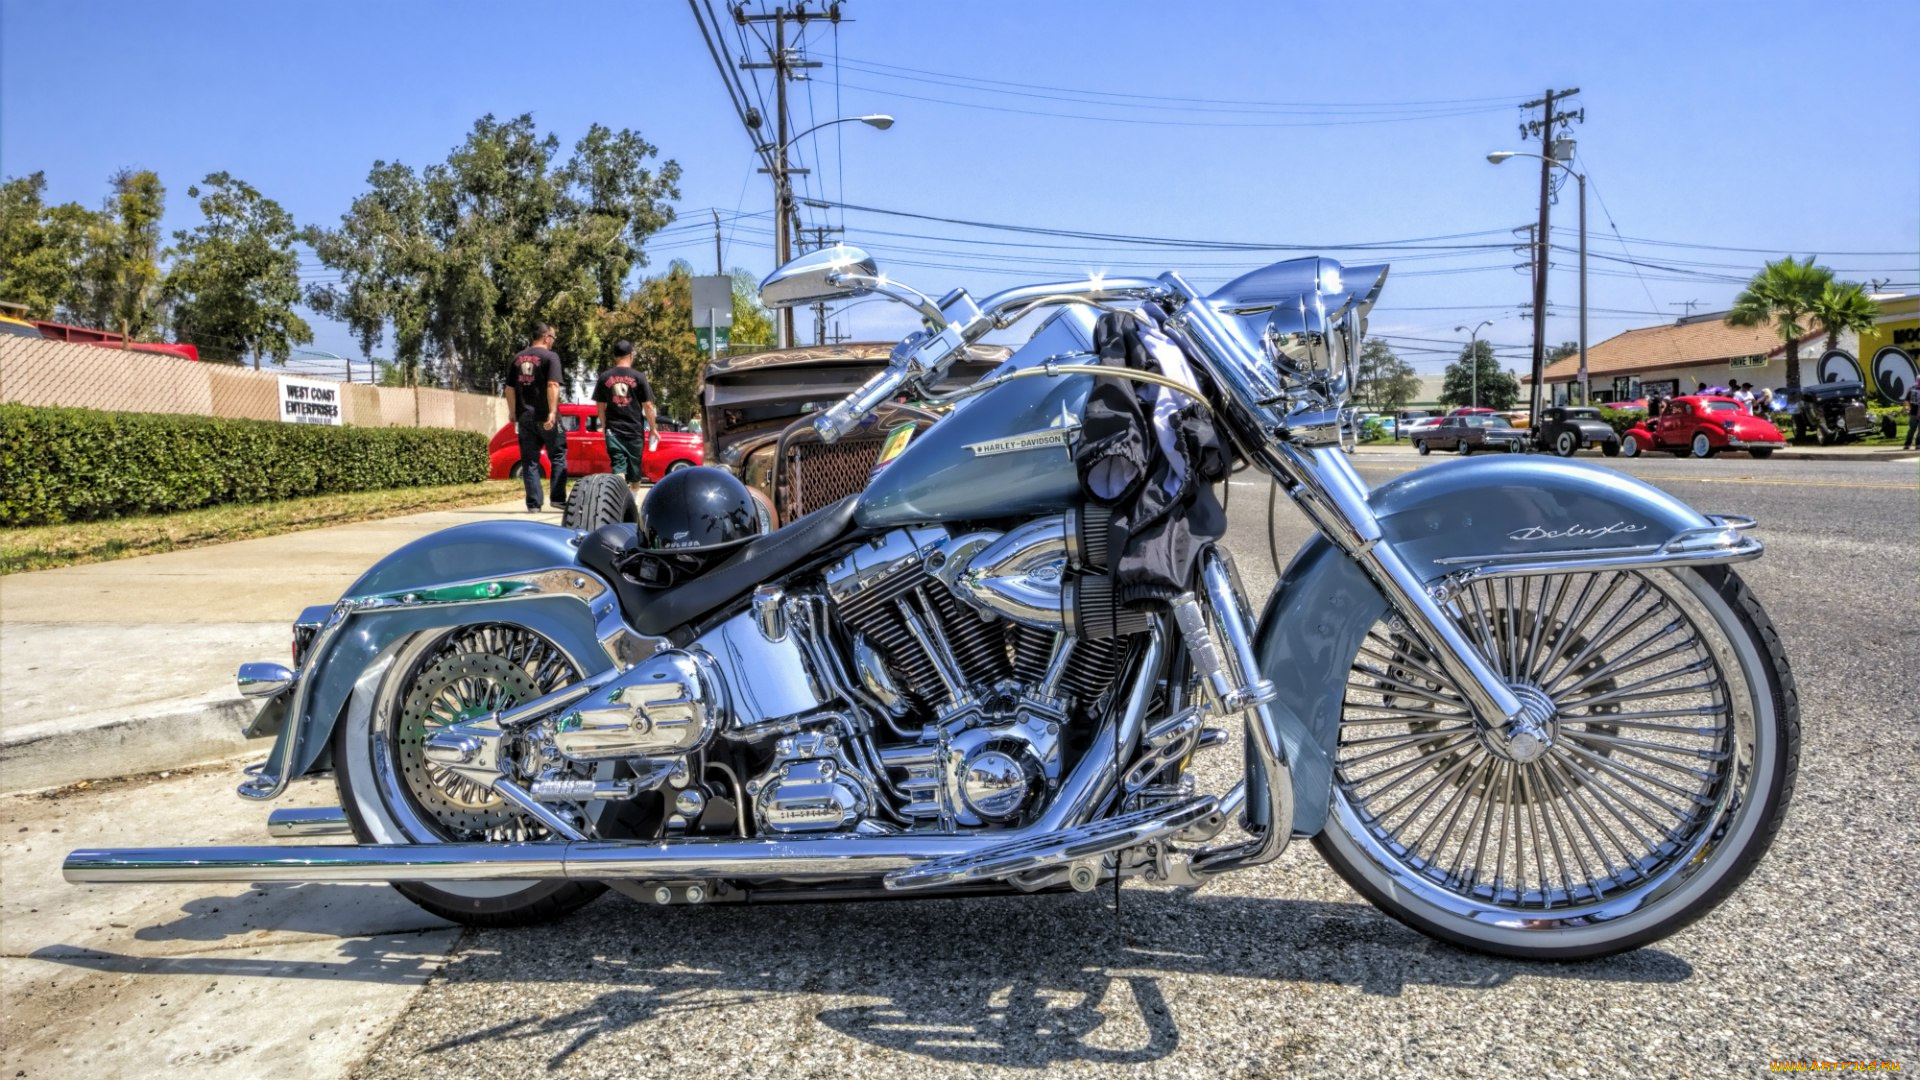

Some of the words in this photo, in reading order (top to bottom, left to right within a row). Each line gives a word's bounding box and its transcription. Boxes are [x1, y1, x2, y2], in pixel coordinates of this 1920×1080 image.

[286, 384, 309, 400] WEST
[310, 387, 335, 402] COAST
[285, 400, 339, 419] ENTERPRISES
[983, 434, 1061, 453] HARLEY-DAVIDSON
[1506, 521, 1648, 541] Deluxe
